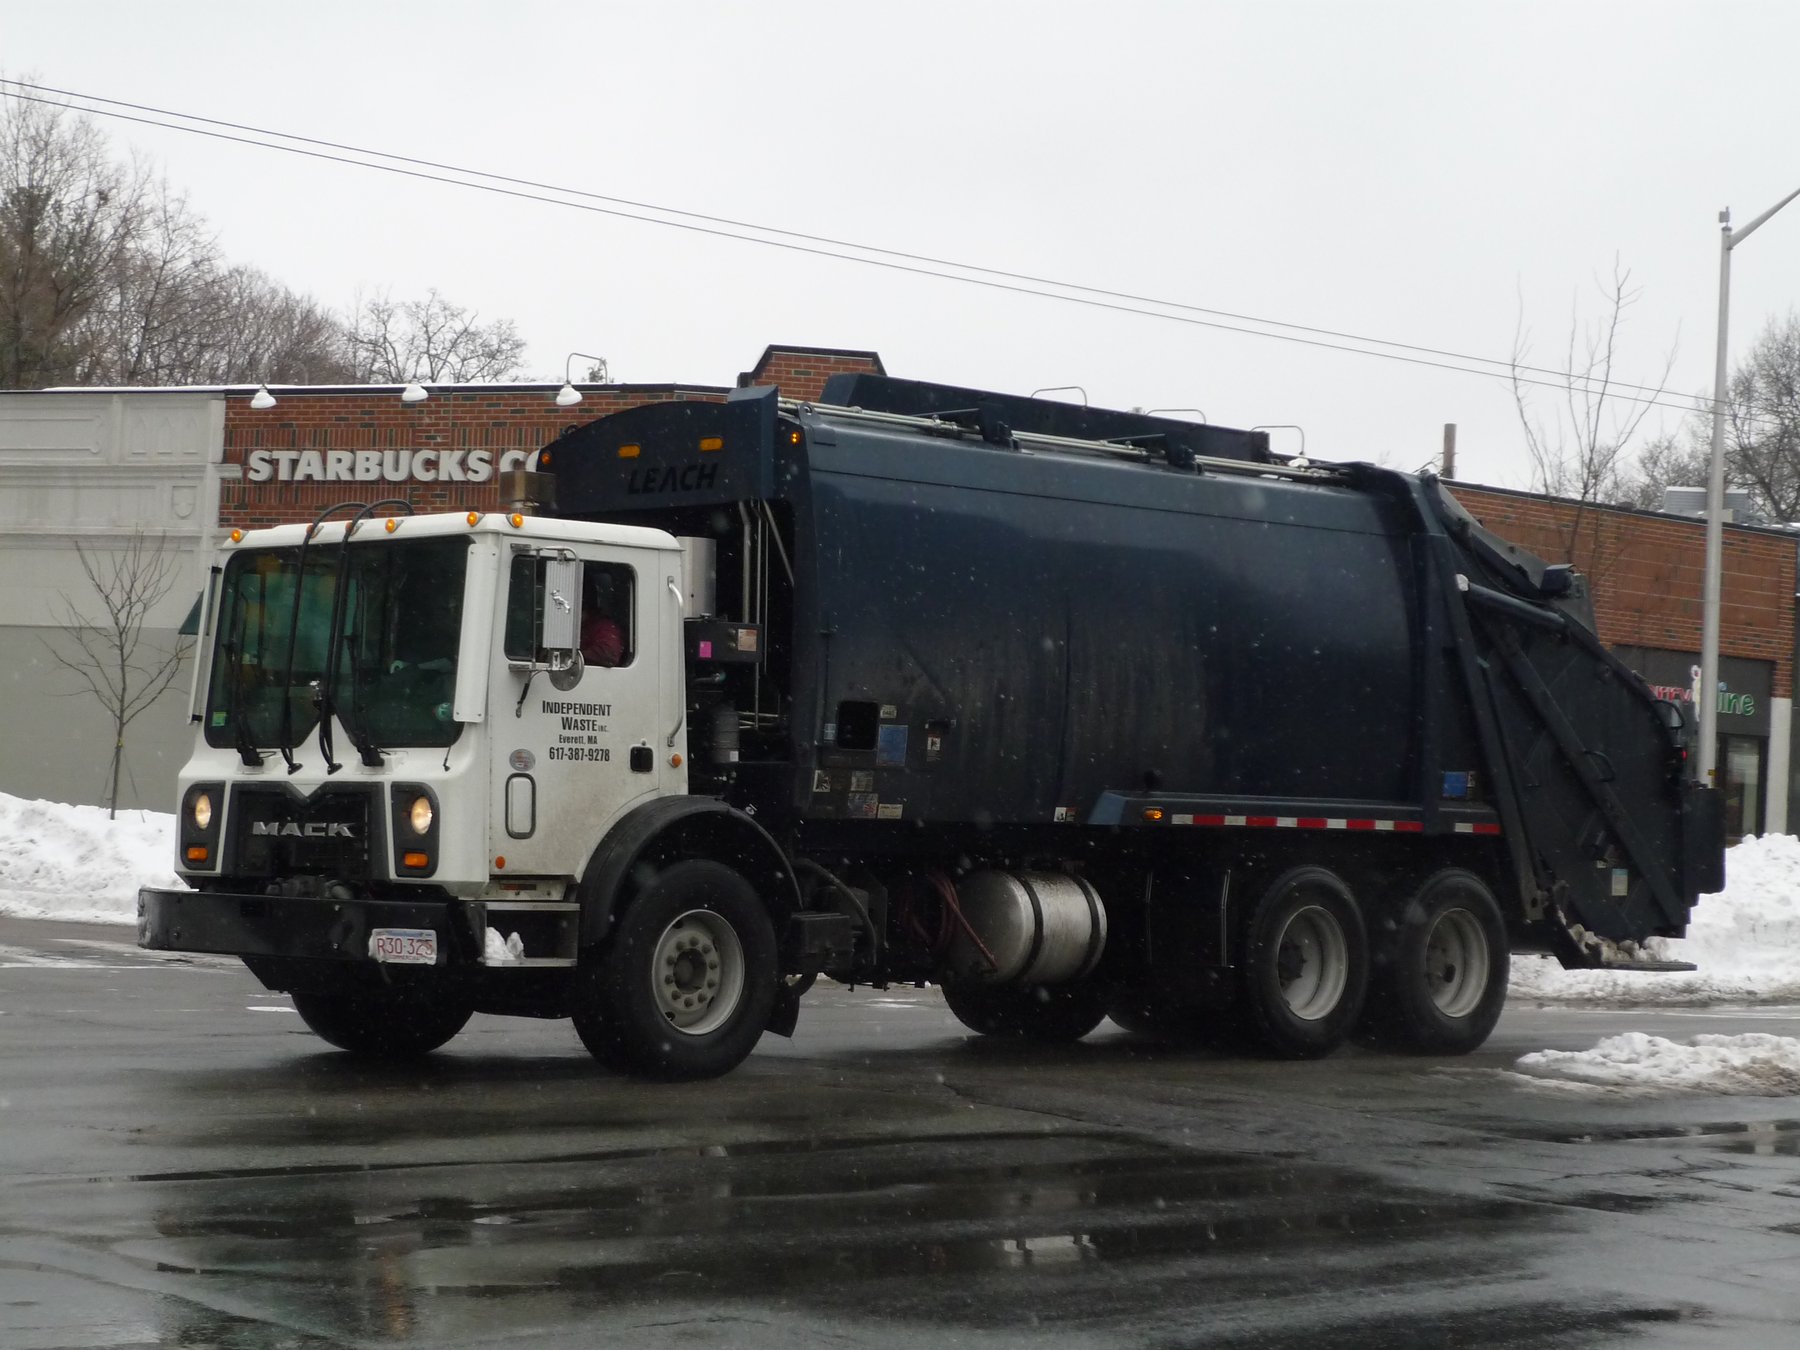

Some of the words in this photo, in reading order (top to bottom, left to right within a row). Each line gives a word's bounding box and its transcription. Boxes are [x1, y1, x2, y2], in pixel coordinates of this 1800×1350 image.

[248, 449, 493, 482] STARBUCKS
[500, 449, 540, 473] C
[628, 463, 719, 495] LEACH
[542, 700, 612, 716] INDEPENDENT
[561, 716, 597, 731] WASTE
[587, 735, 598, 744] MA
[549, 746, 610, 761] 617-387-9278
[252, 821, 355, 838] MACK
